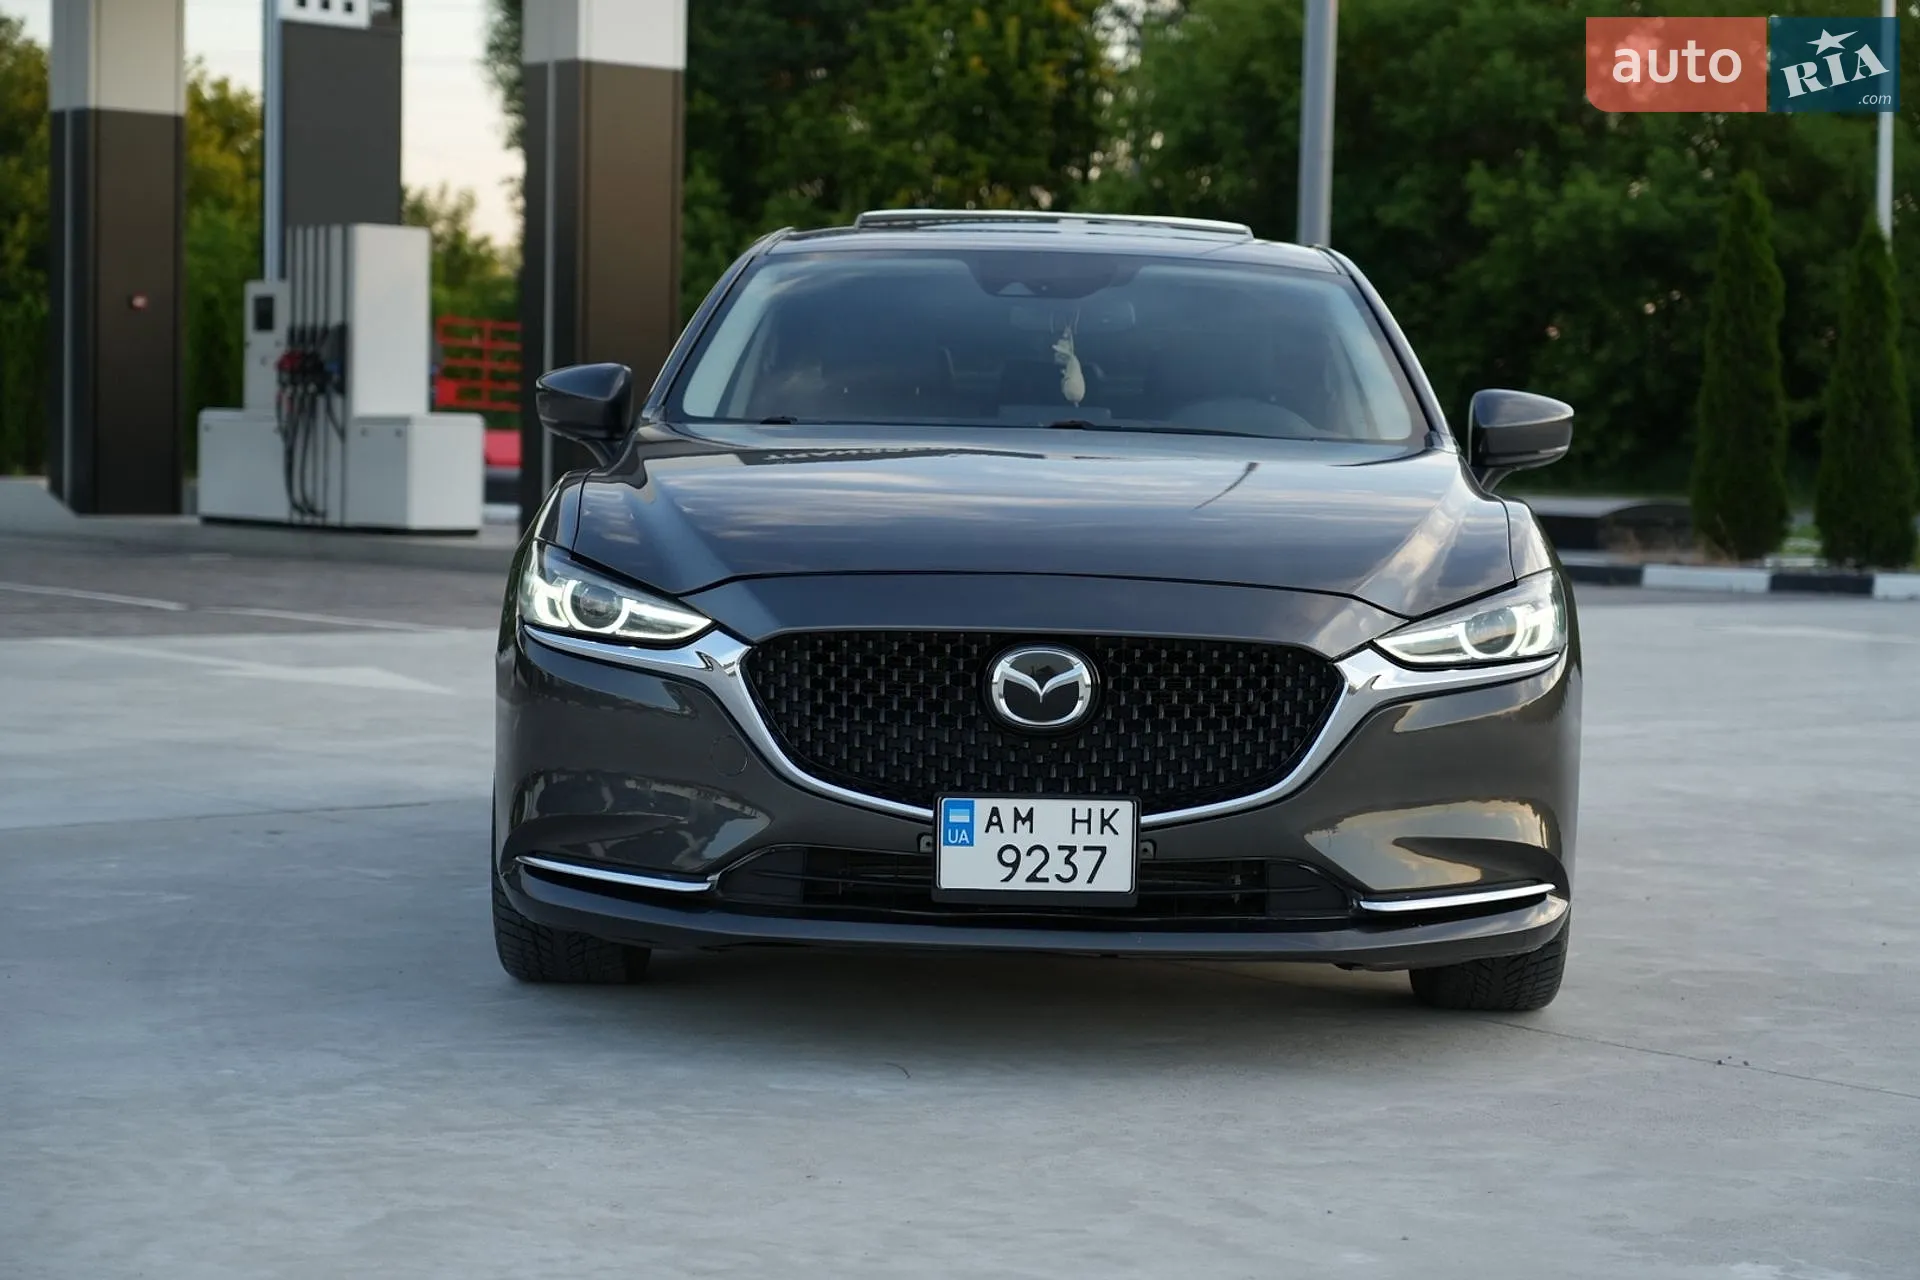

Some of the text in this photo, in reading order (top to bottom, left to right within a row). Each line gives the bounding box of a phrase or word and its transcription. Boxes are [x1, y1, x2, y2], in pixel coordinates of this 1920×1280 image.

[984, 806, 1119, 835] AM HK
[947, 829, 969, 844] UA
[997, 843, 1107, 884] 9237
